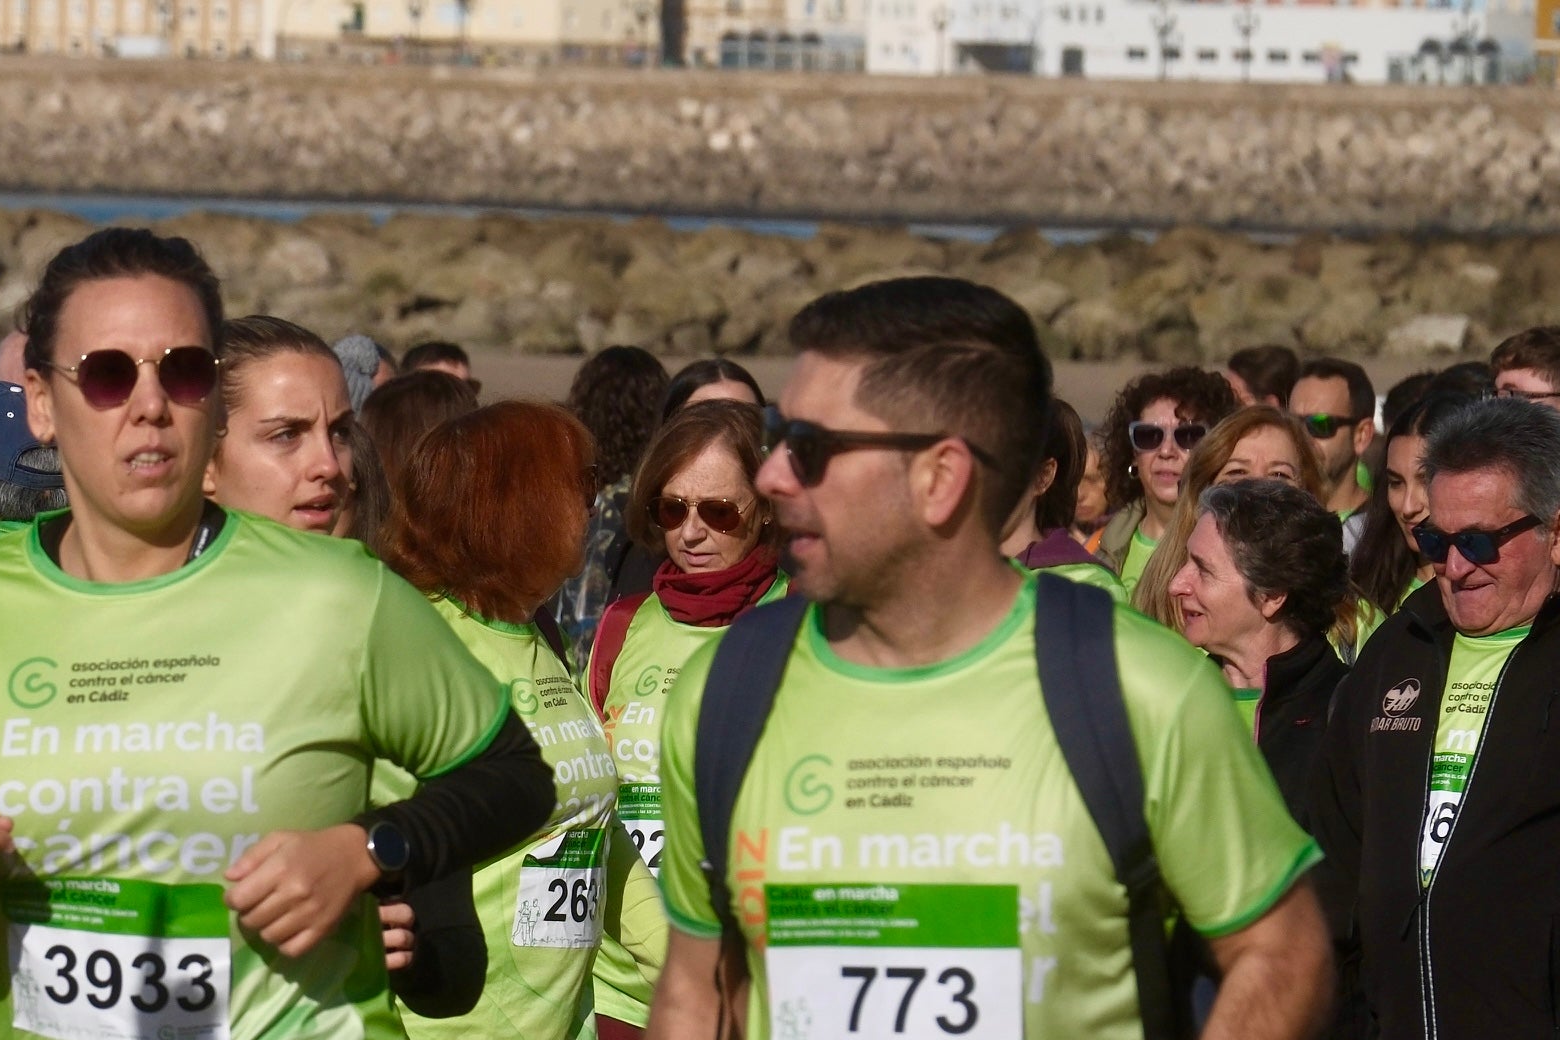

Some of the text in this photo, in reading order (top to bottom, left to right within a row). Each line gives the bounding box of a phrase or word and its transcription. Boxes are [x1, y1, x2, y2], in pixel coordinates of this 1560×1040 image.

[71, 653, 221, 673] asociación española
[69, 671, 187, 688] contra el cáncer
[66, 690, 130, 704] en Cádiz
[544, 697, 568, 709] en Cádiz
[1448, 692, 1480, 702] contra
[622, 701, 655, 725] En
[1445, 702, 1486, 714] en Cádiz
[1391, 717, 1422, 731] BRUTO
[1, 711, 266, 757] En marcha
[554, 748, 616, 784] ontra
[848, 754, 1012, 771] asociación española
[1433, 753, 1467, 764] marcha
[846, 774, 975, 789] contra el cáncer
[200, 766, 260, 814] el
[845, 793, 914, 808] en Cádiz
[778, 821, 1064, 872] En marcha
[66, 879, 120, 894] marcha
[813, 888, 836, 901] en
[838, 885, 899, 901] marcha
[44, 945, 216, 1013] 3933
[841, 966, 979, 1034] 773
